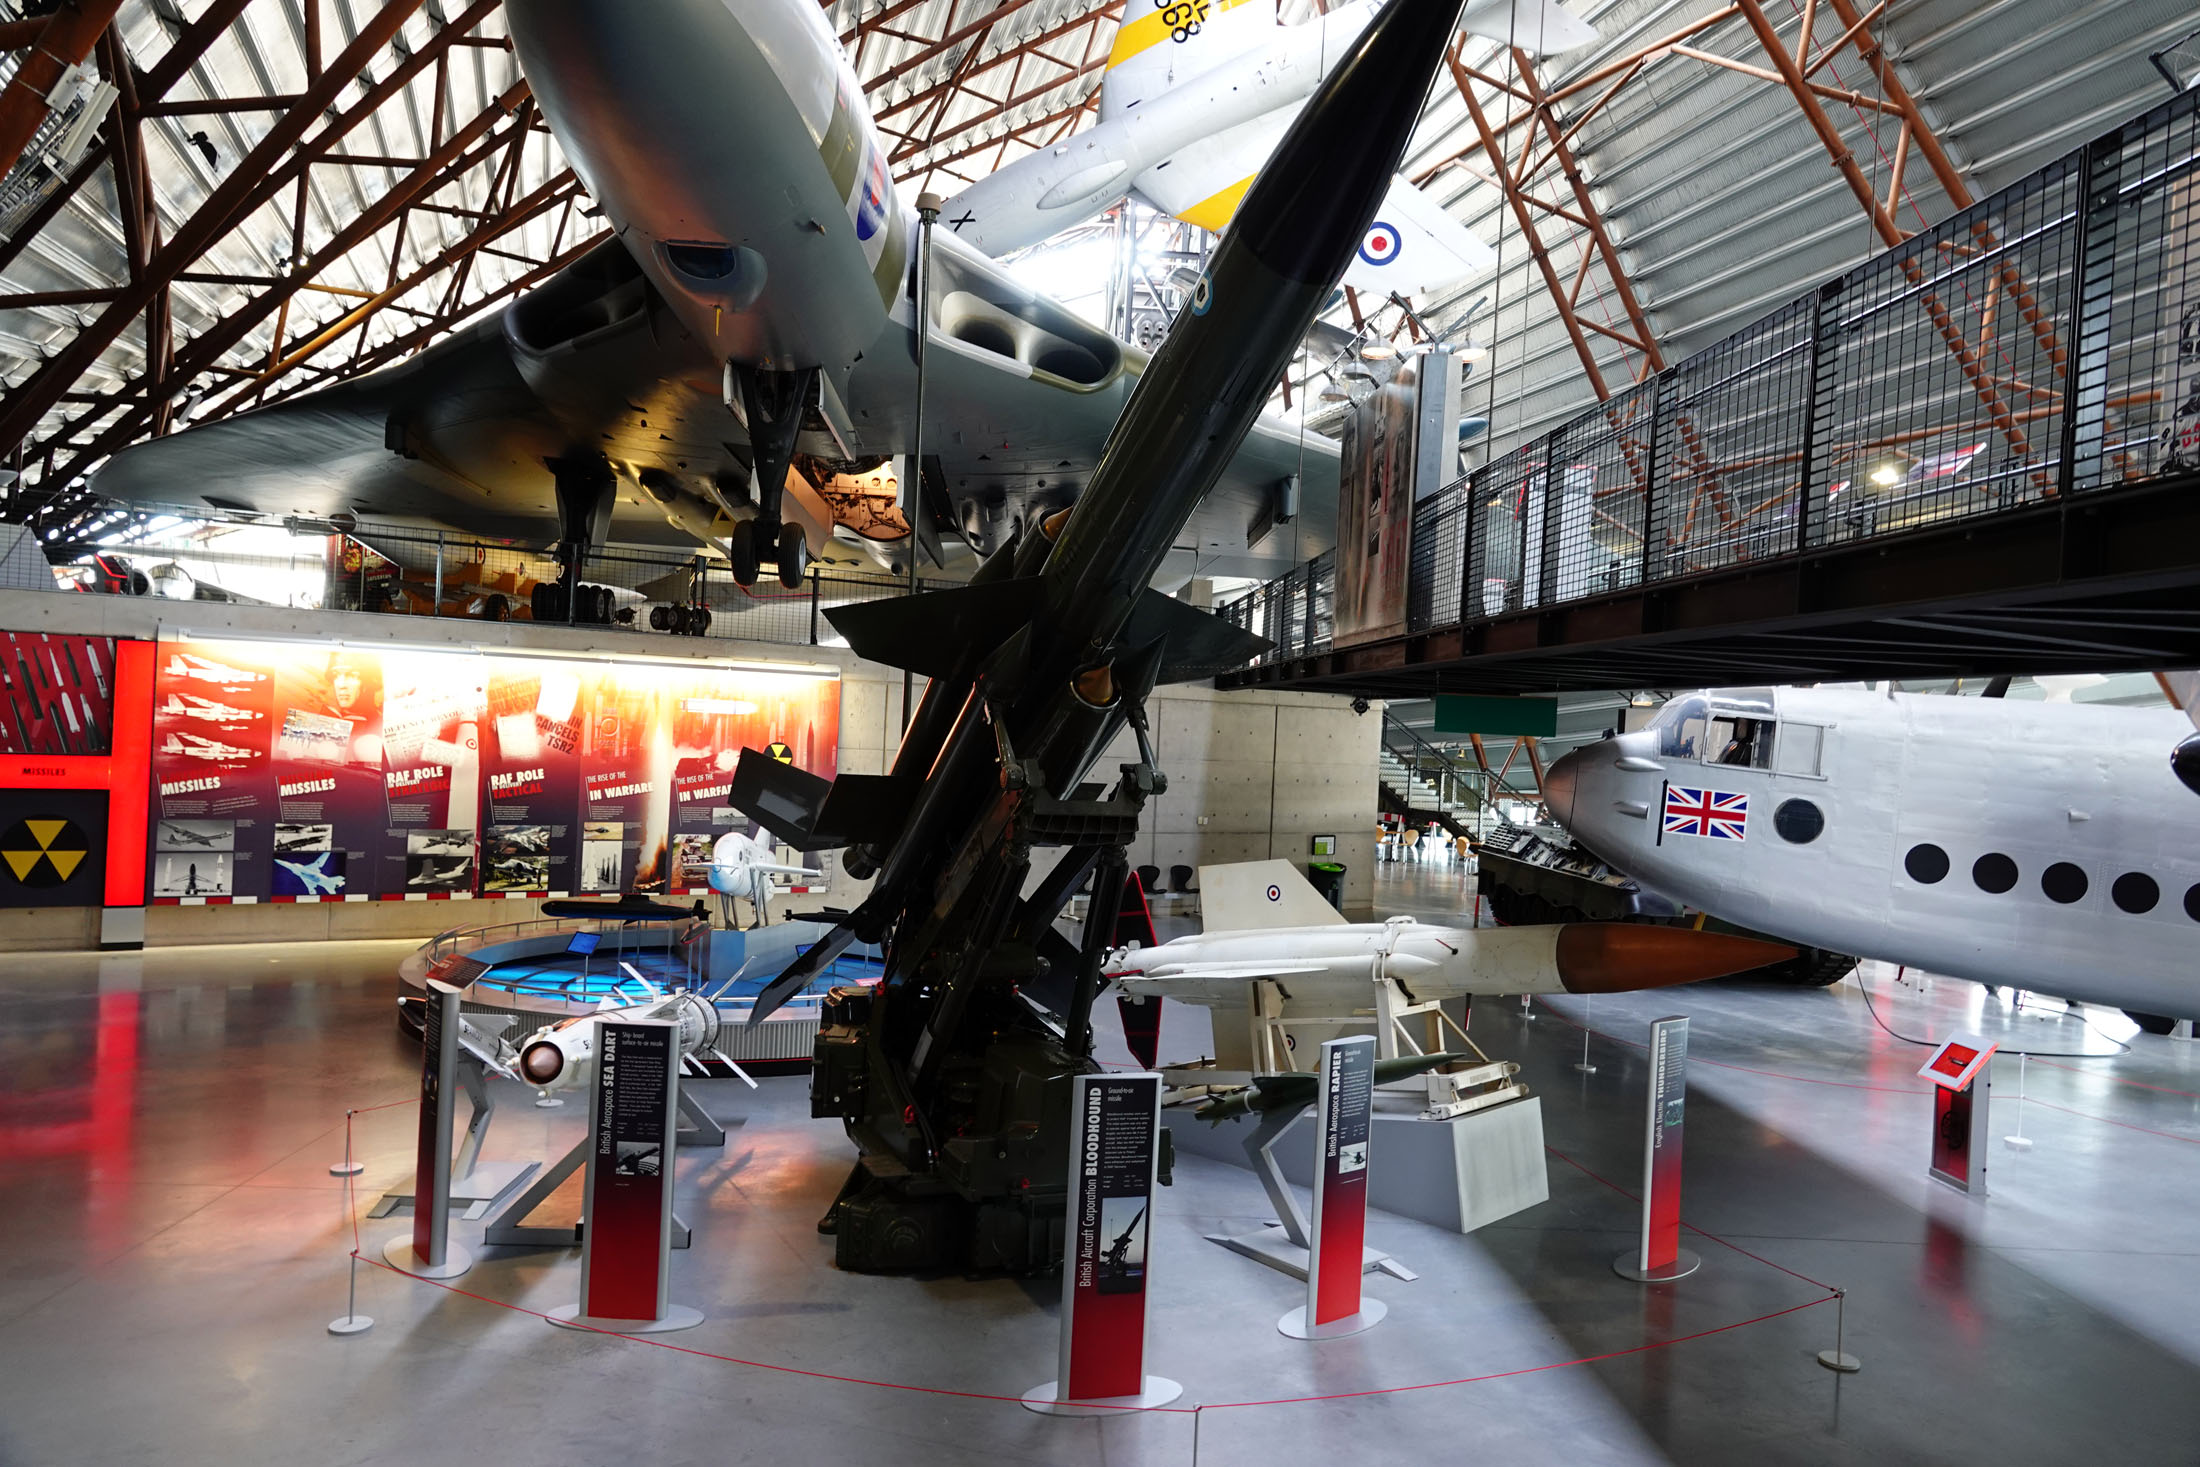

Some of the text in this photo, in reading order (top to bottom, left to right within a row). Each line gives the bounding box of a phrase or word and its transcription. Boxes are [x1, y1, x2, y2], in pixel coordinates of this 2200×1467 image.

[536, 716, 580, 743] CANCELS
[547, 736, 574, 754] TSR2
[23, 768, 65, 776] MISSILES
[386, 766, 444, 785] RAF ROLE
[491, 768, 545, 786] RAF ROLE
[598, 774, 608, 782] RISE
[617, 771, 626, 779] THE
[677, 777, 686, 785] THE
[687, 776, 696, 784] RISE
[705, 773, 713, 781] THE
[161, 777, 221, 795] MISSILES
[280, 778, 336, 796] MISSILES
[492, 783, 543, 799] TACTICAL
[590, 790, 602, 801] IN
[605, 782, 654, 798] WARFARE
[679, 790, 691, 802] IN
[693, 784, 732, 800] WARFA
[1657, 1029, 1667, 1098] THUNDERBIRD
[600, 1030, 617, 1154] British Aerospace SEA DART
[1328, 1051, 1342, 1157] British Aerospace RAPIER
[1079, 1087, 1102, 1287] British Aircraft Corporation BLOODHOUND
